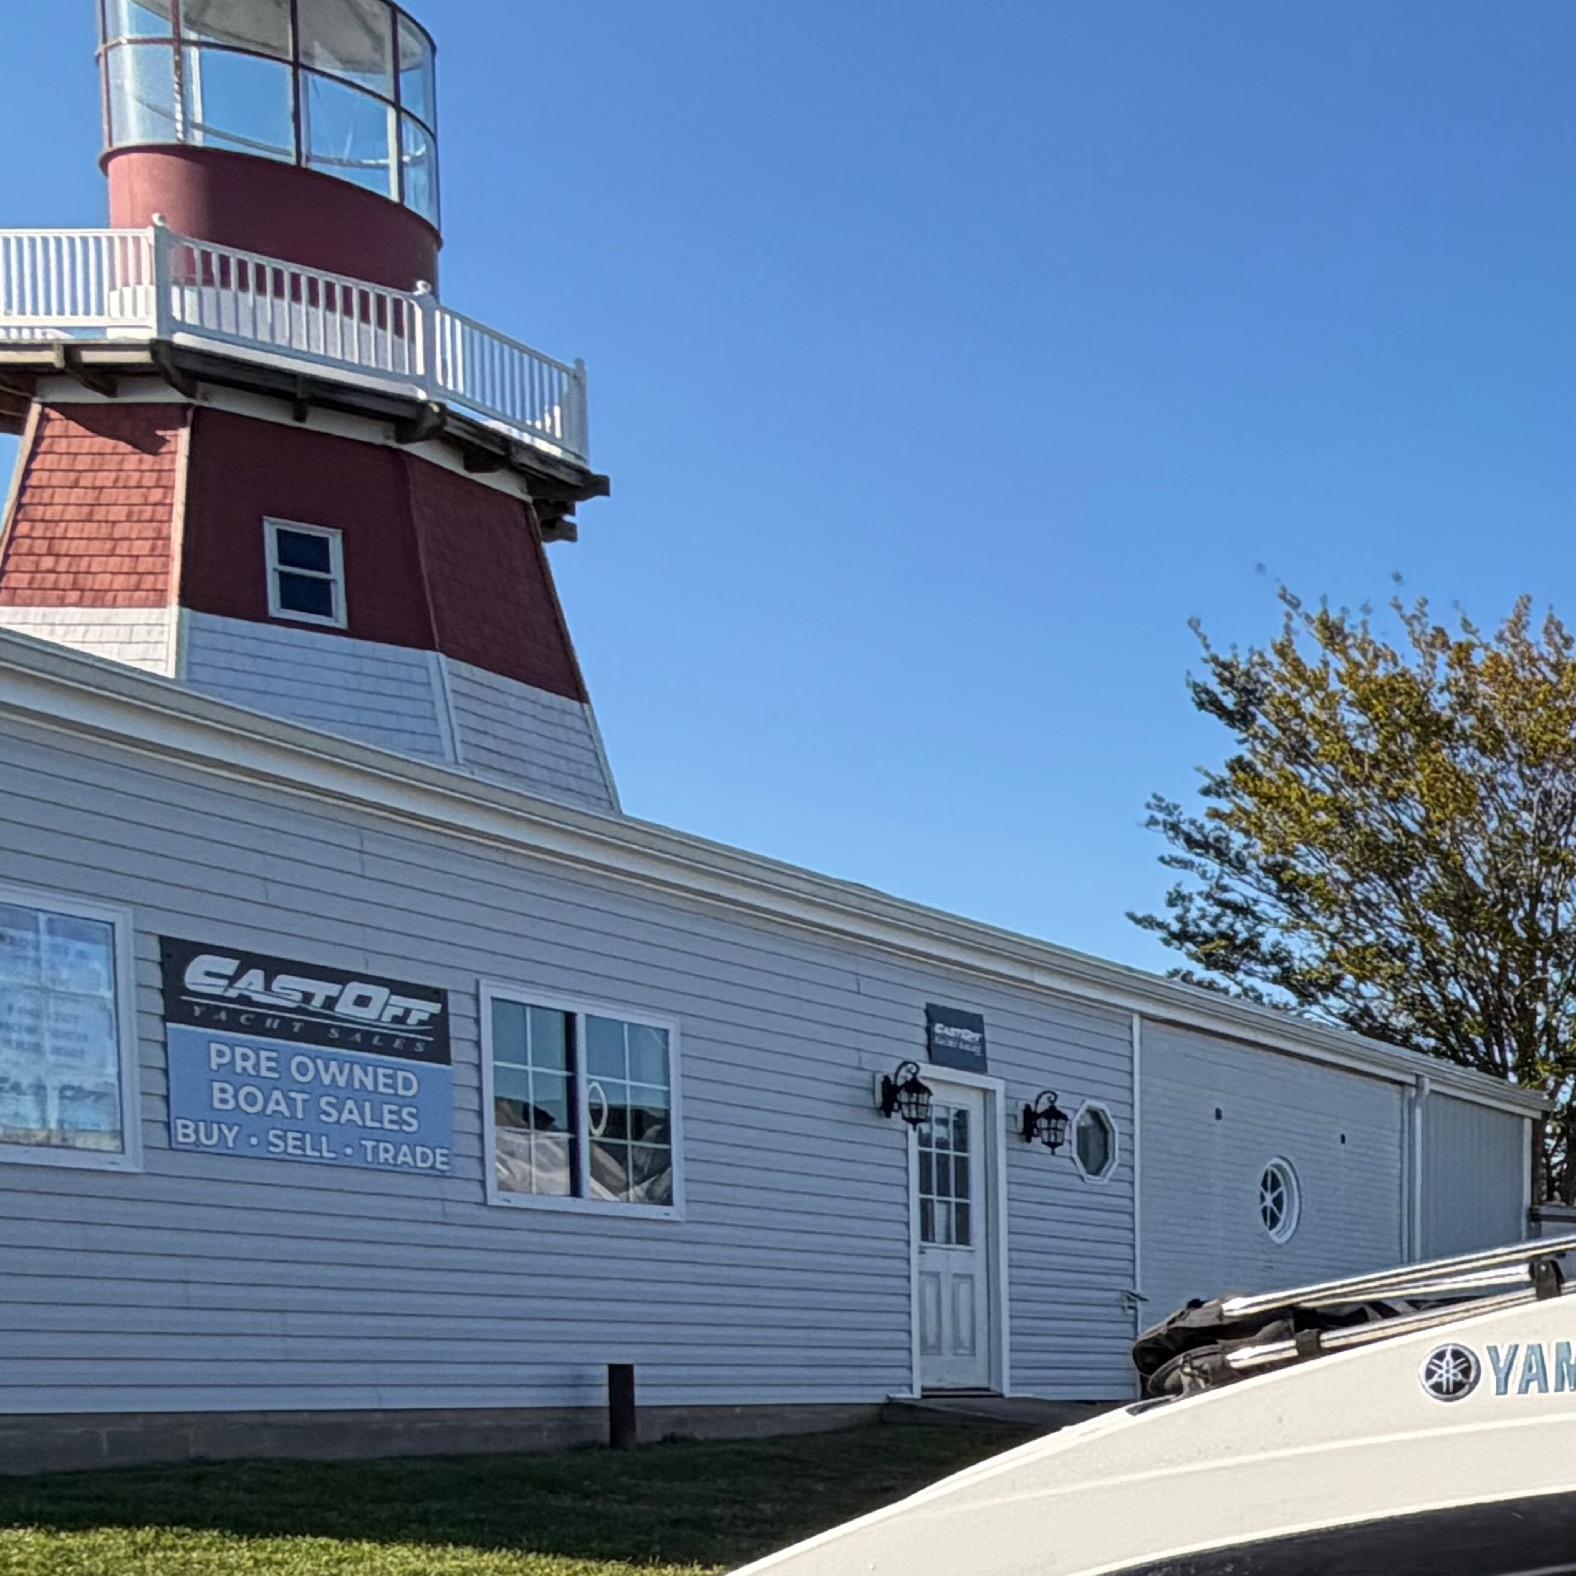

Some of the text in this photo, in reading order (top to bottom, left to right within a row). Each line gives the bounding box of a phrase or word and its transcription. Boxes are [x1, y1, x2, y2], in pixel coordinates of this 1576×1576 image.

[192, 1005, 426, 1053] YACHT SALES
[209, 1042, 419, 1098] PRE OWNED
[211, 1081, 420, 1133] BOAT SALES
[175, 1119, 449, 1170] BUY SELL TRADE
